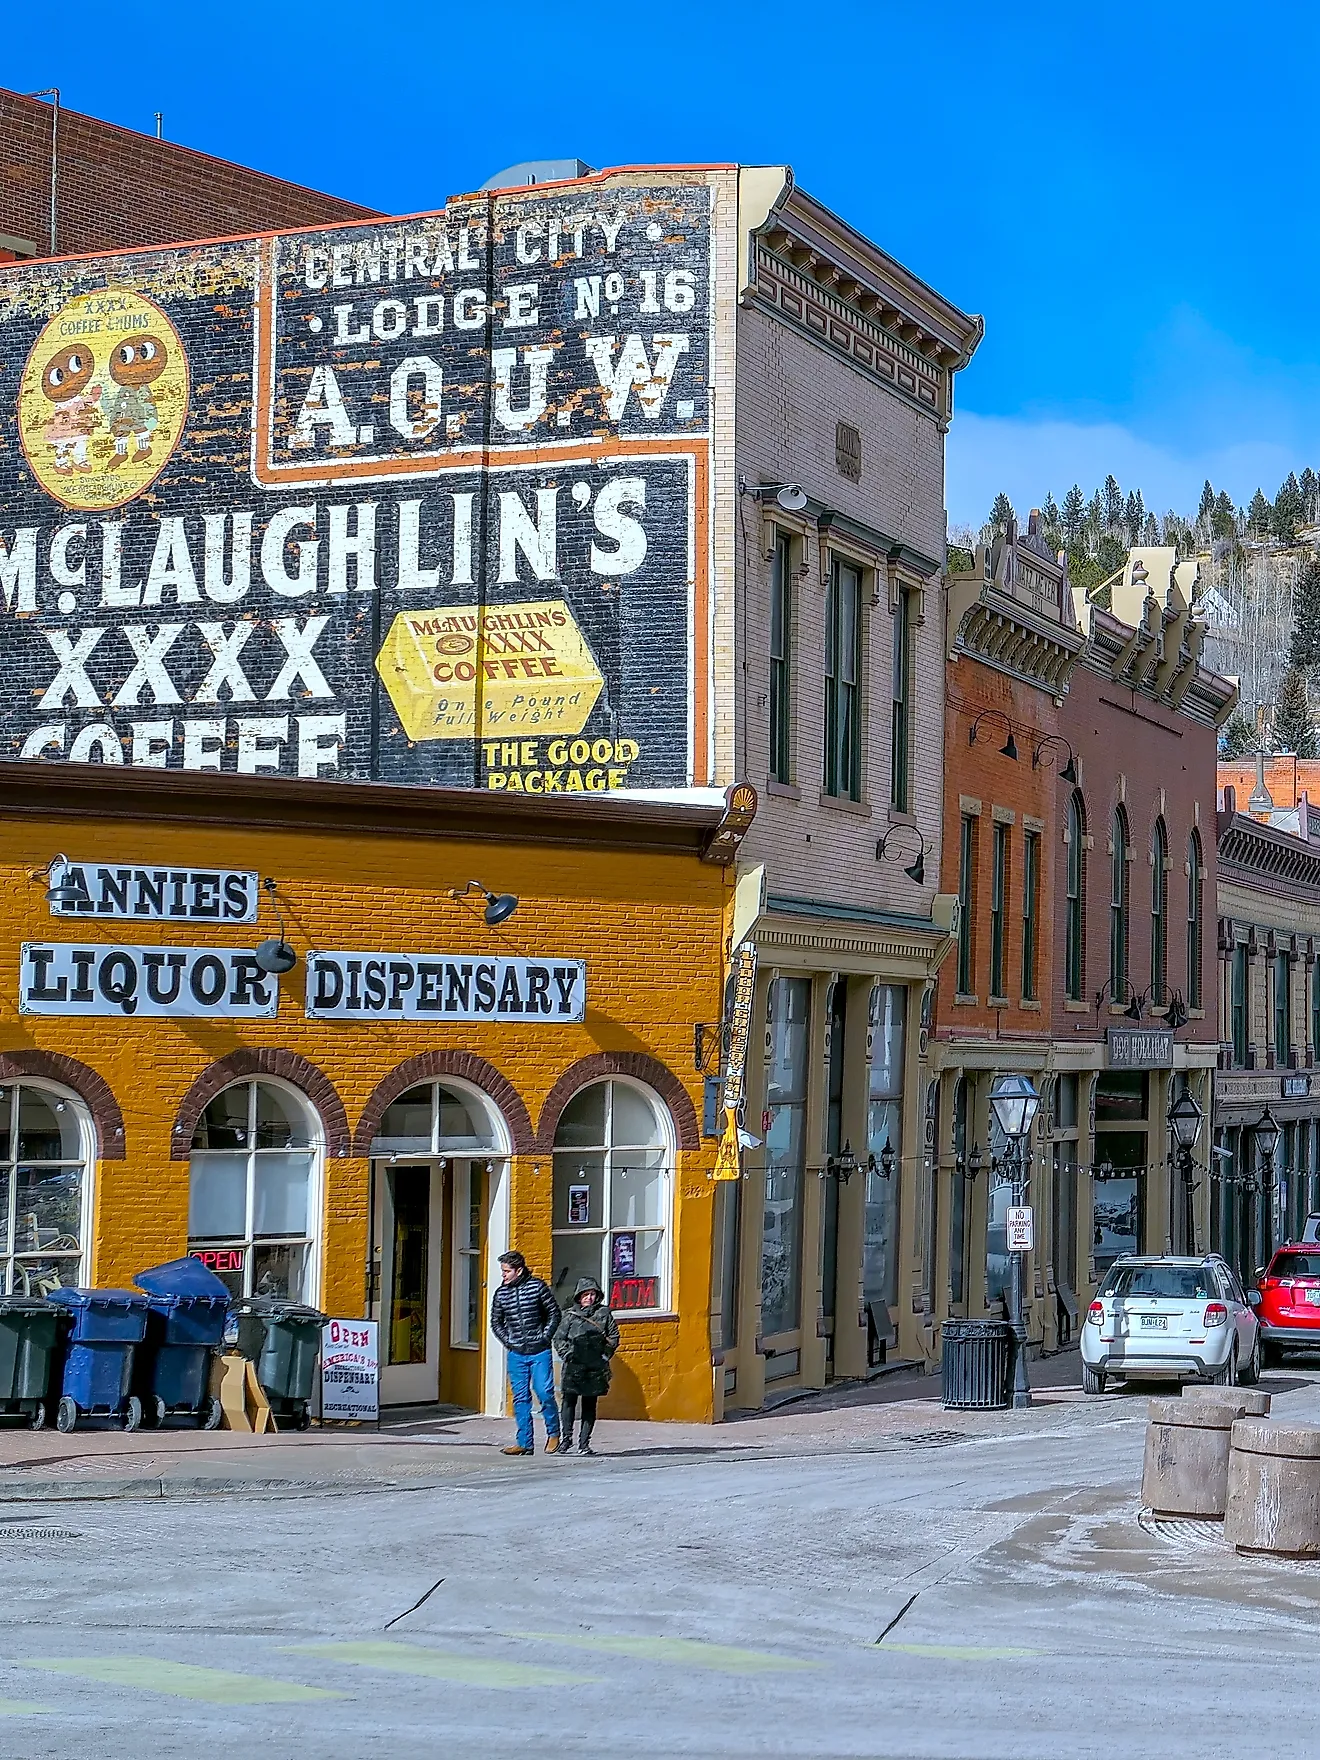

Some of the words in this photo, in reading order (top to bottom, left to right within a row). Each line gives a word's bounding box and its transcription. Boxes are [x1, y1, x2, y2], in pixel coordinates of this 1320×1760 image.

[303, 226, 481, 289] CENTRAL
[516, 217, 626, 264] CITY
[333, 283, 539, 345] LODGE
[639, 269, 696, 314] 16
[60, 319, 101, 336] COFFEE
[478, 630, 556, 654] XXXX
[36, 616, 335, 711] XXXX
[432, 656, 564, 683] COFFEE
[512, 692, 581, 708] Pound
[433, 711, 474, 726] Full
[488, 707, 566, 724] Weight
[482, 743, 538, 767] THE
[548, 738, 640, 766] GOOD
[488, 768, 628, 793] PACKAGE
[62, 867, 249, 919] ANNIES
[27, 949, 273, 1014] LIQUOR
[312, 959, 580, 1014] DISPENSARY
[1112, 1036, 1129, 1060] DOC
[1131, 1034, 1169, 1060] HOLLIDAY
[1010, 1220, 1030, 1228] PARKING
[1015, 1211, 1025, 1220] NO
[609, 1278, 656, 1309] ATM
[330, 1321, 369, 1347] OPEN
[324, 1371, 376, 1385] DISPENSARY
[324, 1404, 377, 1413] RECREATIONAL
